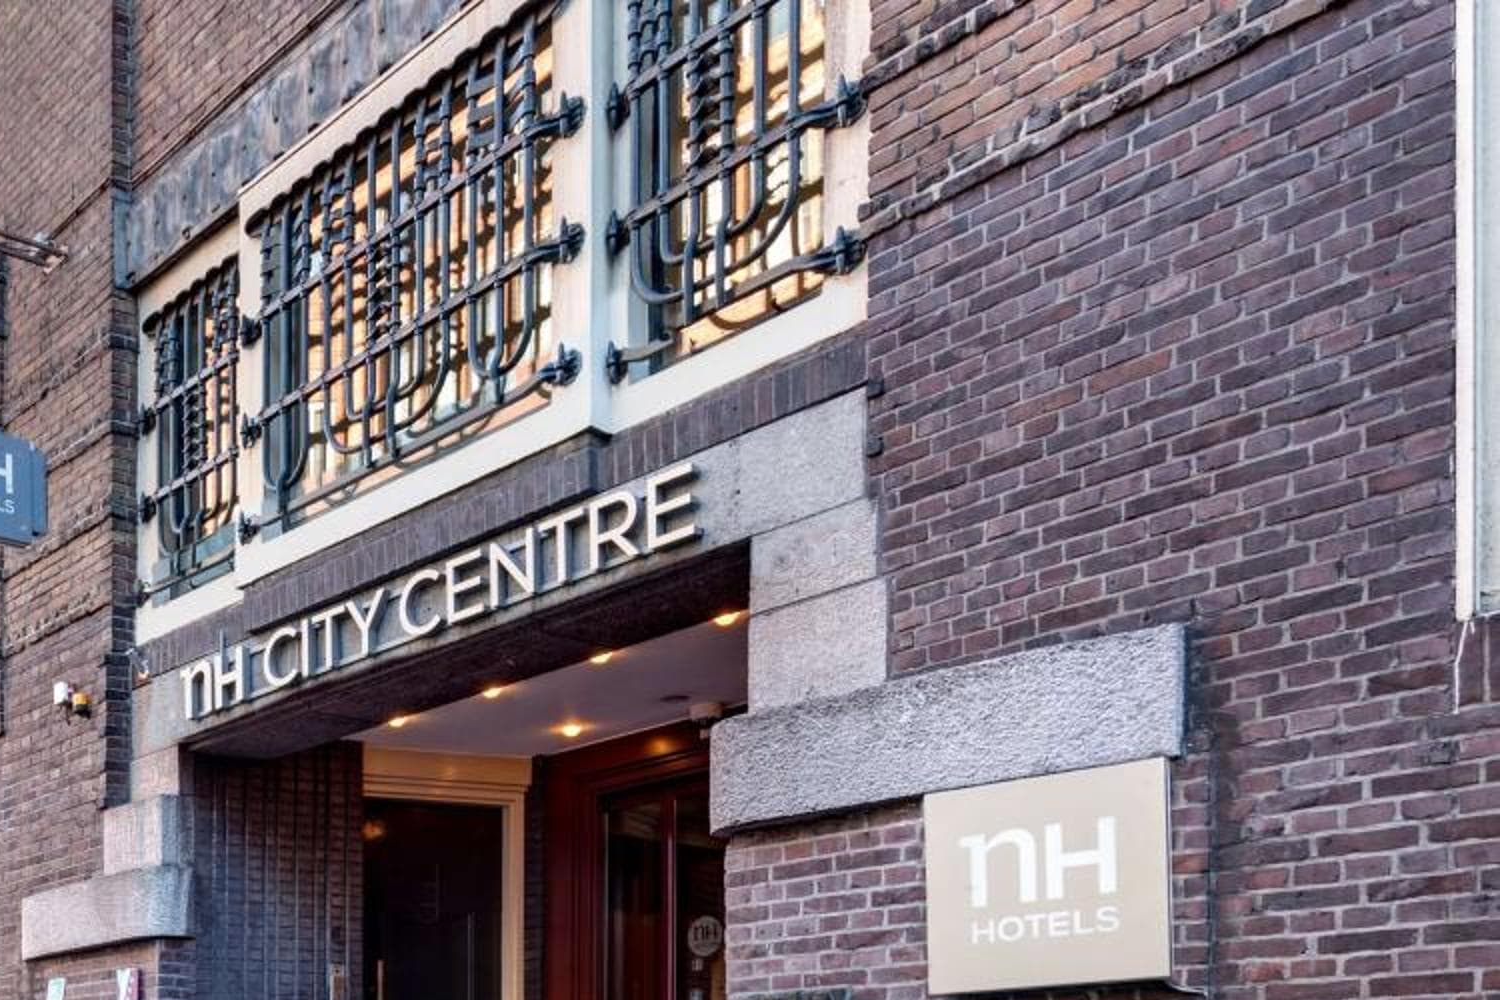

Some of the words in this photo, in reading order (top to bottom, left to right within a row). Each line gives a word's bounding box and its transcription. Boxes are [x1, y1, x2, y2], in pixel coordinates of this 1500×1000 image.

[263, 589, 385, 688] CITY
[398, 461, 697, 637] CENTRE
[958, 815, 1117, 908] nH
[970, 906, 1120, 944] HOTELS
